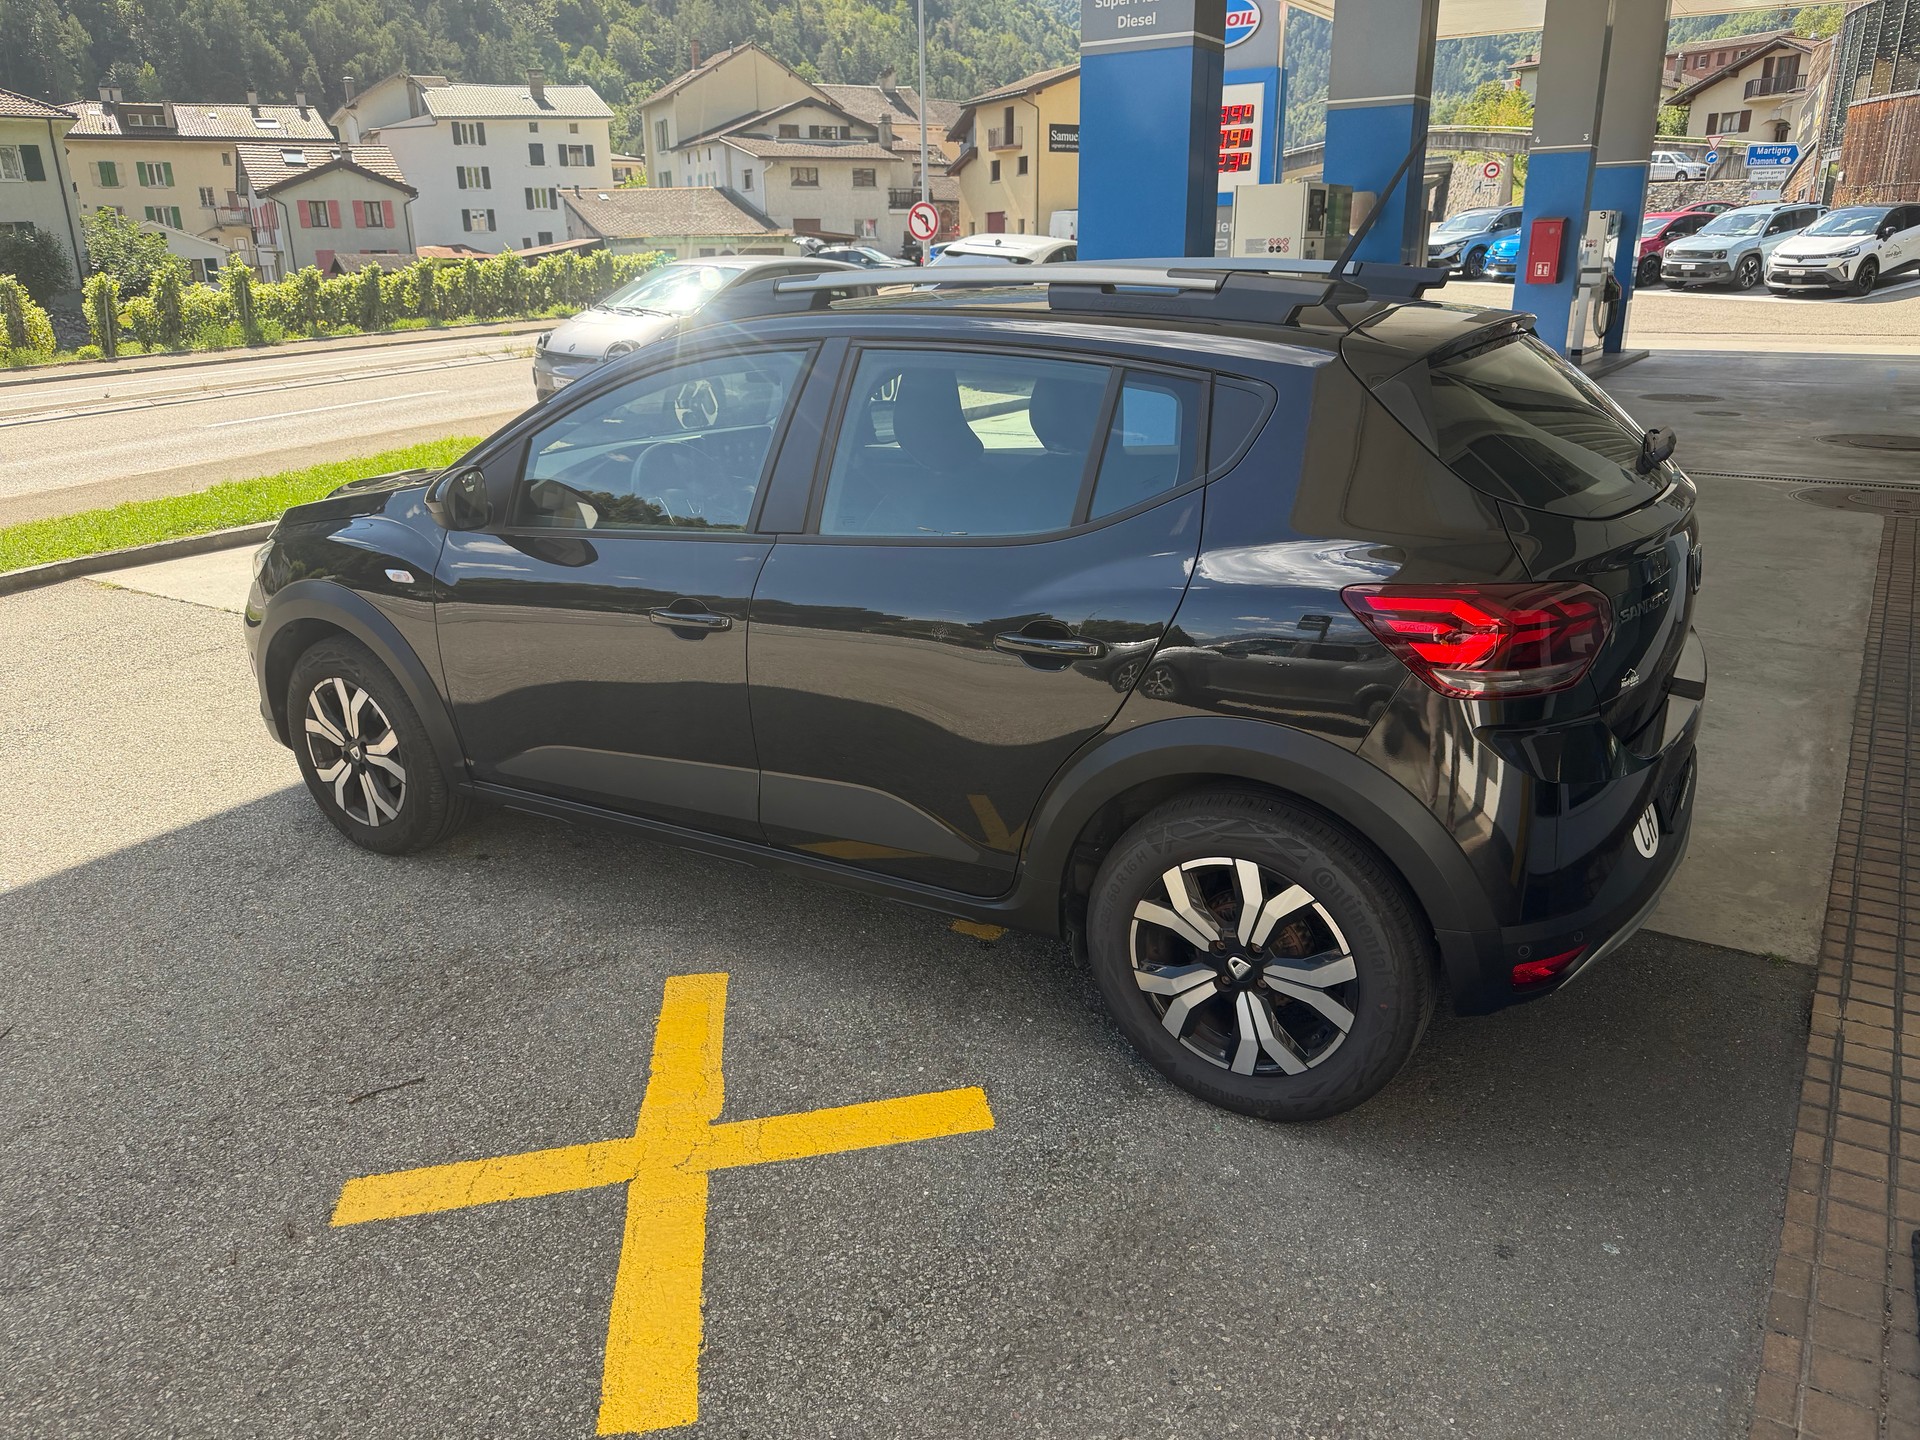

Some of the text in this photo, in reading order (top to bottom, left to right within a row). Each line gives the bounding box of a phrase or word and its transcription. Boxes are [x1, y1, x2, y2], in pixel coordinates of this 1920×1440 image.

[1118, 12, 1156, 28] Diesel
[1226, 12, 1256, 26] OIL
[1583, 133, 1589, 141] 3
[1756, 147, 1791, 156] Martigny
[1600, 211, 1607, 220] 3
[1311, 867, 1393, 976] Continental
